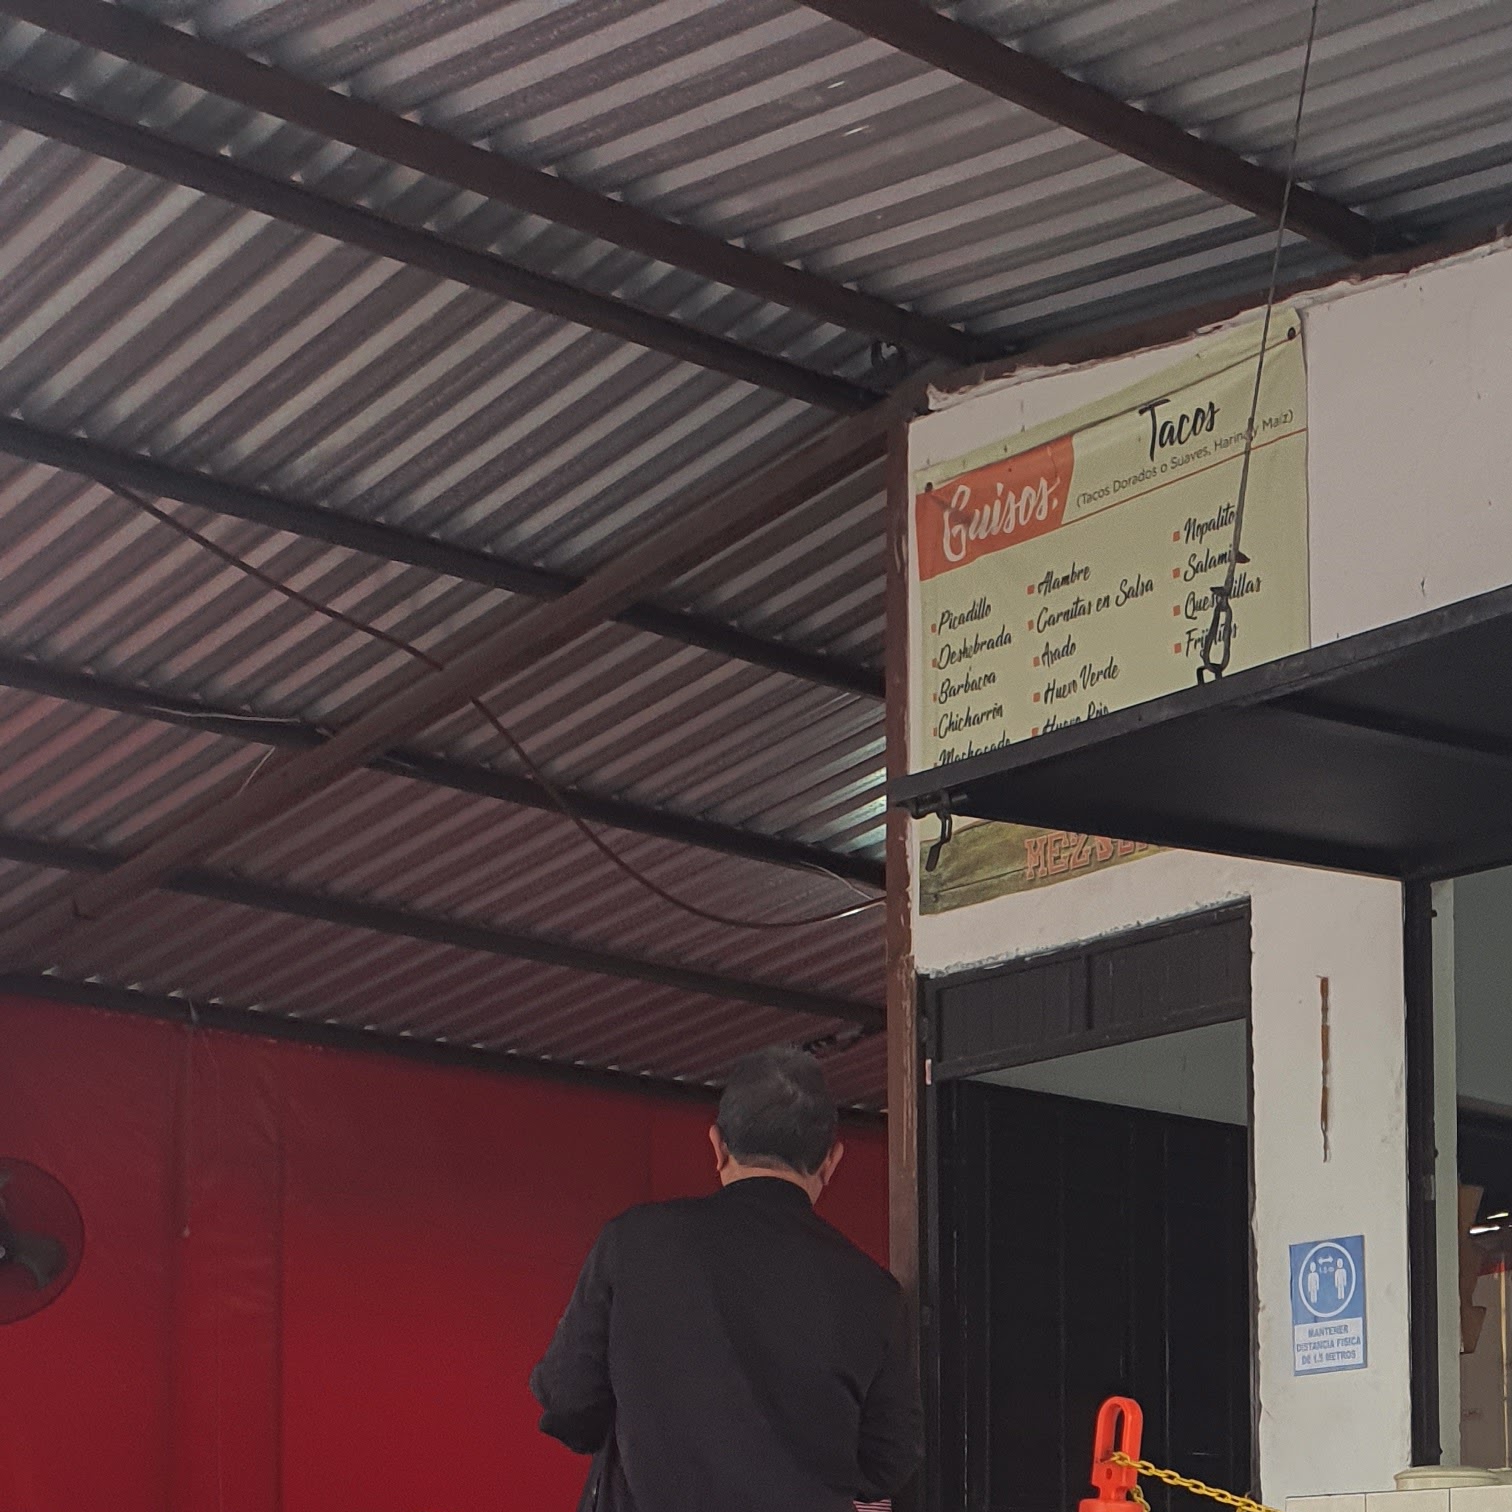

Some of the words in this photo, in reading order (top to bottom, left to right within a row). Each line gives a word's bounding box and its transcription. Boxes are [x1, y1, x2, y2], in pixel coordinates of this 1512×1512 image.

[1138, 398, 1221, 462] Tacos
[1076, 485, 1110, 508] (Tacos
[1113, 463, 1157, 494] Dorados
[1160, 463, 1168, 474] o
[1170, 445, 1211, 470] Suaves,
[1037, 561, 1091, 597] Alambre
[1184, 572, 1261, 620] Quesillas
[938, 596, 992, 636] Picadillo
[1036, 596, 1092, 634] Carnitas
[1096, 594, 1111, 612] en
[1115, 573, 1154, 607] Salsa
[937, 624, 1012, 670] Deshebrada
[1041, 634, 1076, 668] Asado
[938, 671, 997, 705] Barbacoa
[1043, 678, 1078, 705] Huevo
[1080, 656, 1120, 690] Verde
[1296, 1340, 1335, 1352] DISTANCIA
[1308, 1324, 1348, 1338] MANTENER
[1325, 1350, 1356, 1360] METROS
